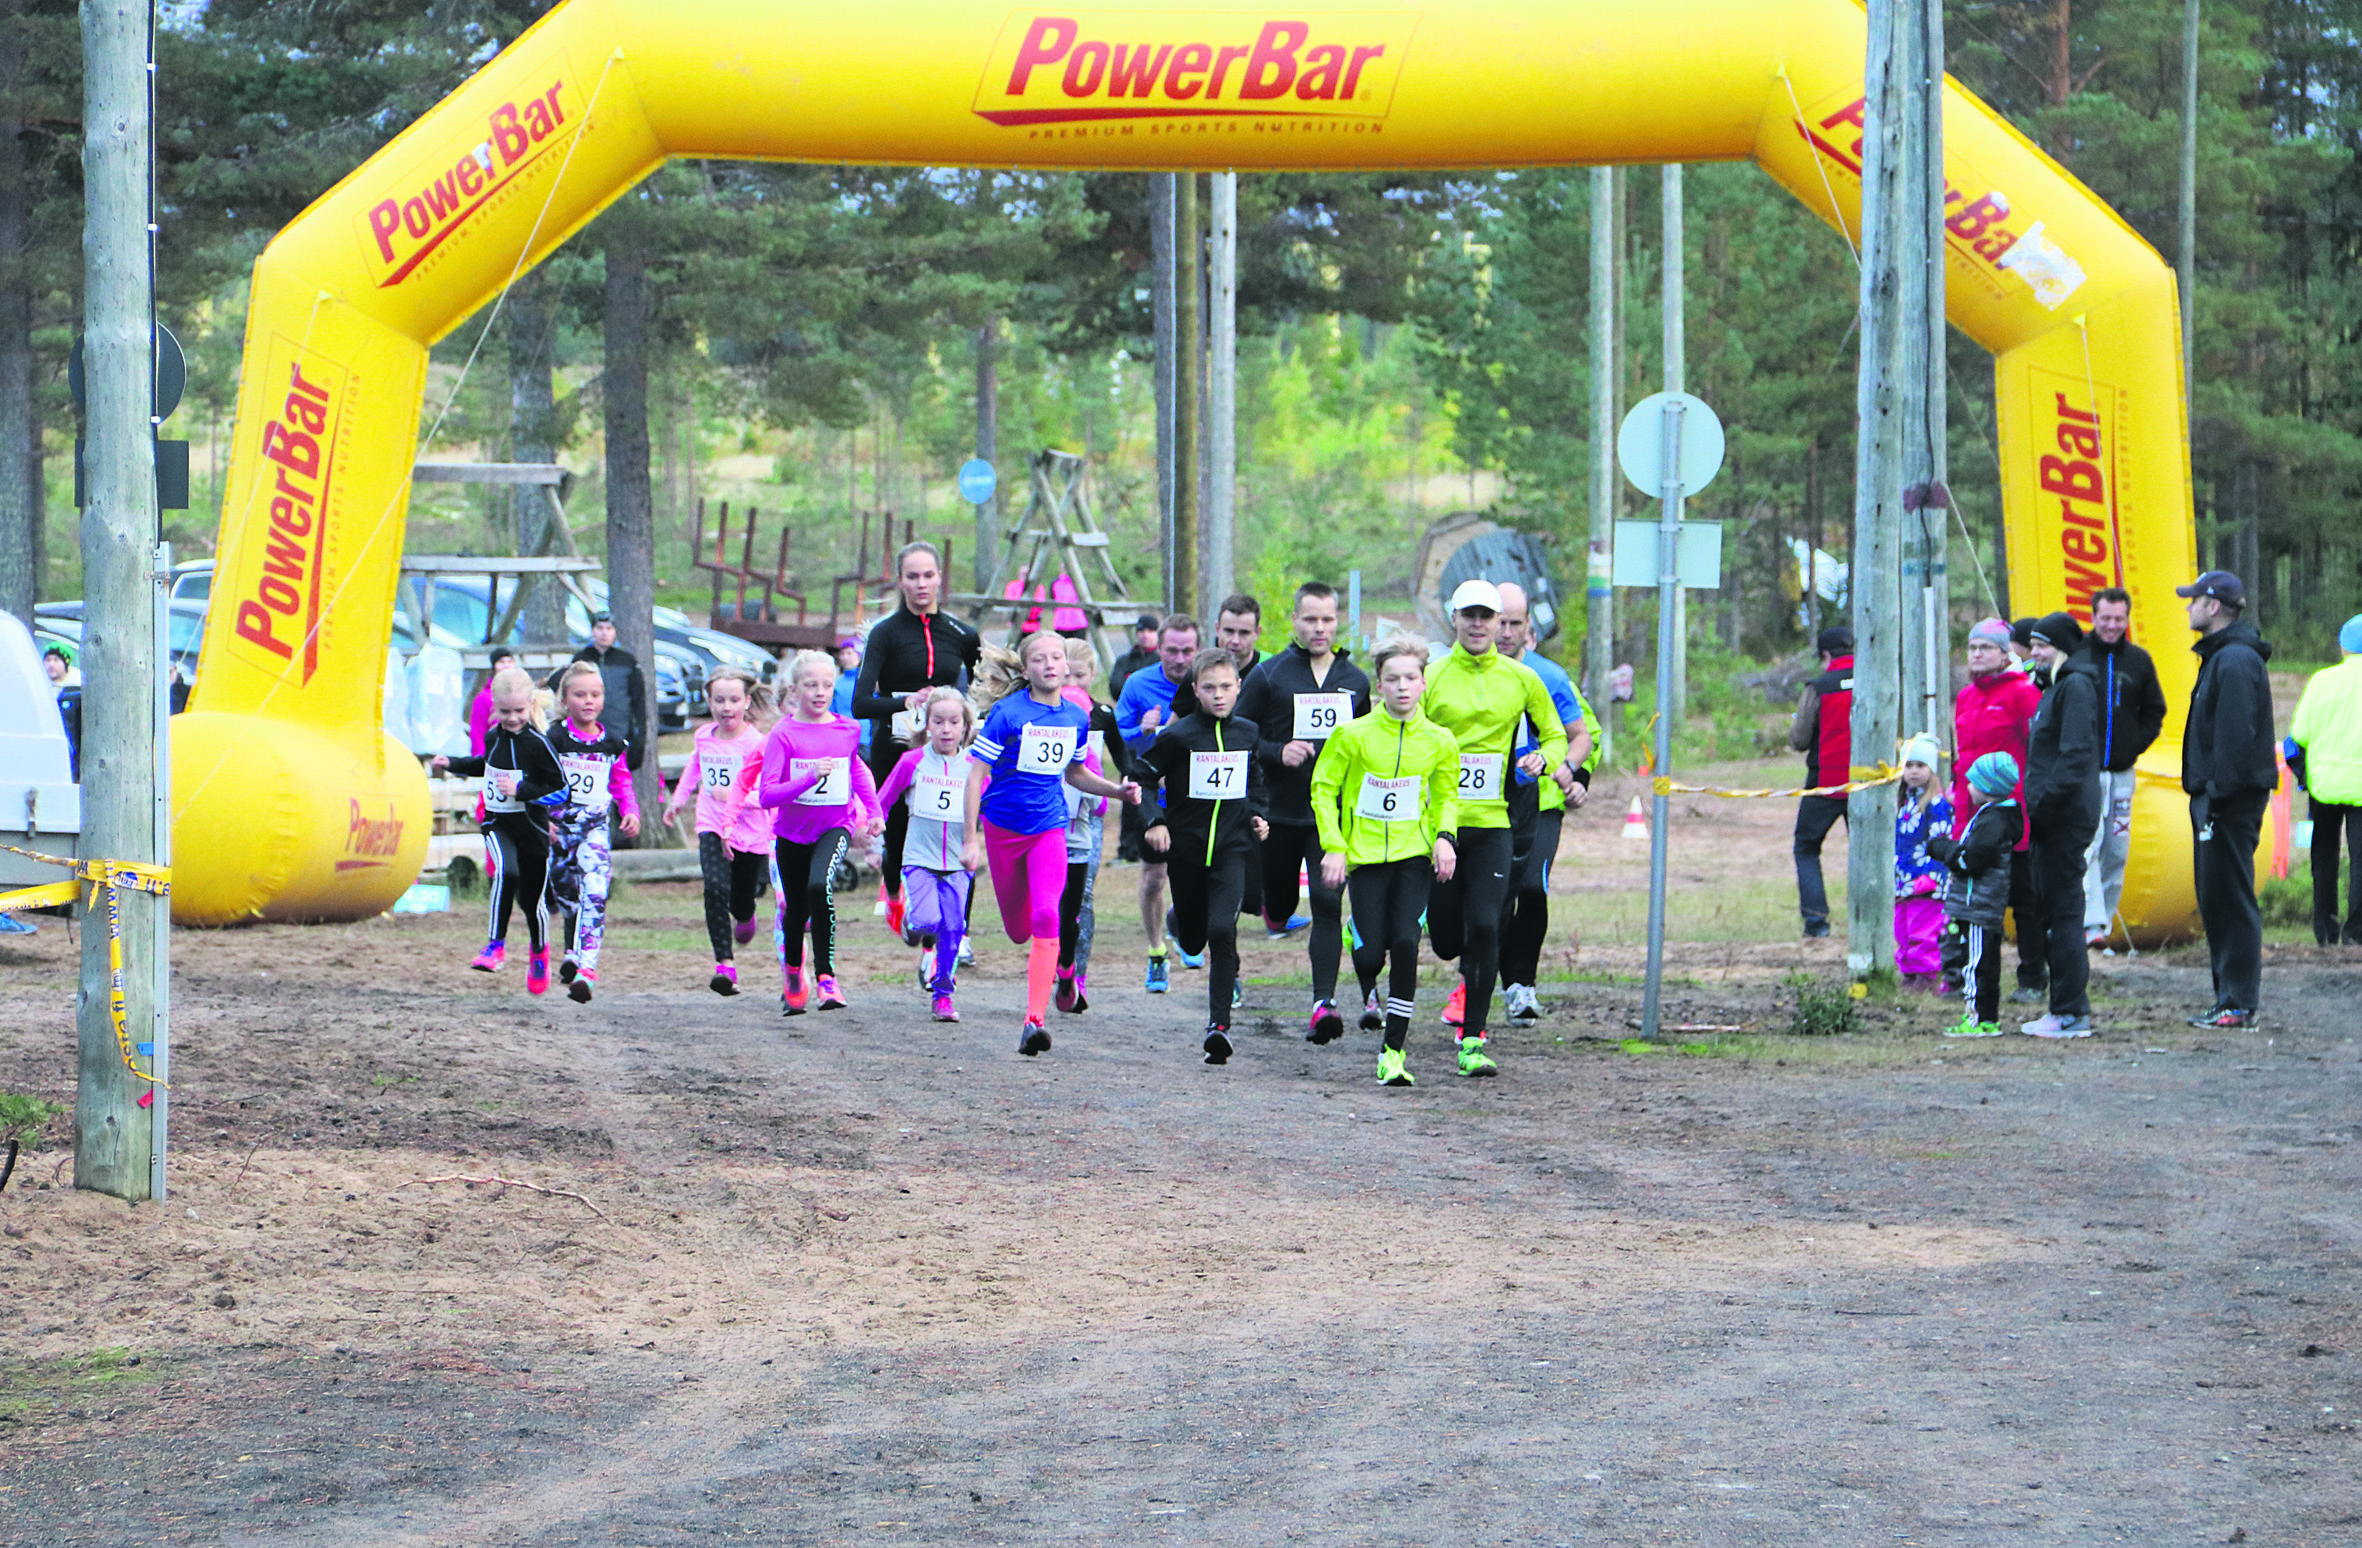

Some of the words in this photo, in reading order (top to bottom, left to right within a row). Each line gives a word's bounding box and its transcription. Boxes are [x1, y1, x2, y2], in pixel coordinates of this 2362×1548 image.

[1004, 16, 1386, 100] PowerBar
[1029, 124, 1135, 140] PREMIUM
[1150, 121, 1238, 135] SPORTS
[1254, 120, 1384, 135] NUTRITION
[368, 80, 565, 265] PowerBar
[235, 361, 330, 661] PowerBar
[2040, 391, 2108, 632] werBar
[1311, 708, 1337, 728] 59
[1037, 741, 1064, 764] 39
[1196, 754, 1239, 763] RANTALAKEUS
[569, 773, 594, 794] 29
[707, 768, 730, 787] 35
[815, 775, 828, 795] 2
[922, 775, 964, 789] RANTALAKEUS
[1206, 767, 1234, 788] 47
[1367, 775, 1411, 790] RANTALAKEUS
[1459, 768, 1486, 789] 28
[938, 790, 951, 810] 5
[1383, 792, 1397, 812] 6
